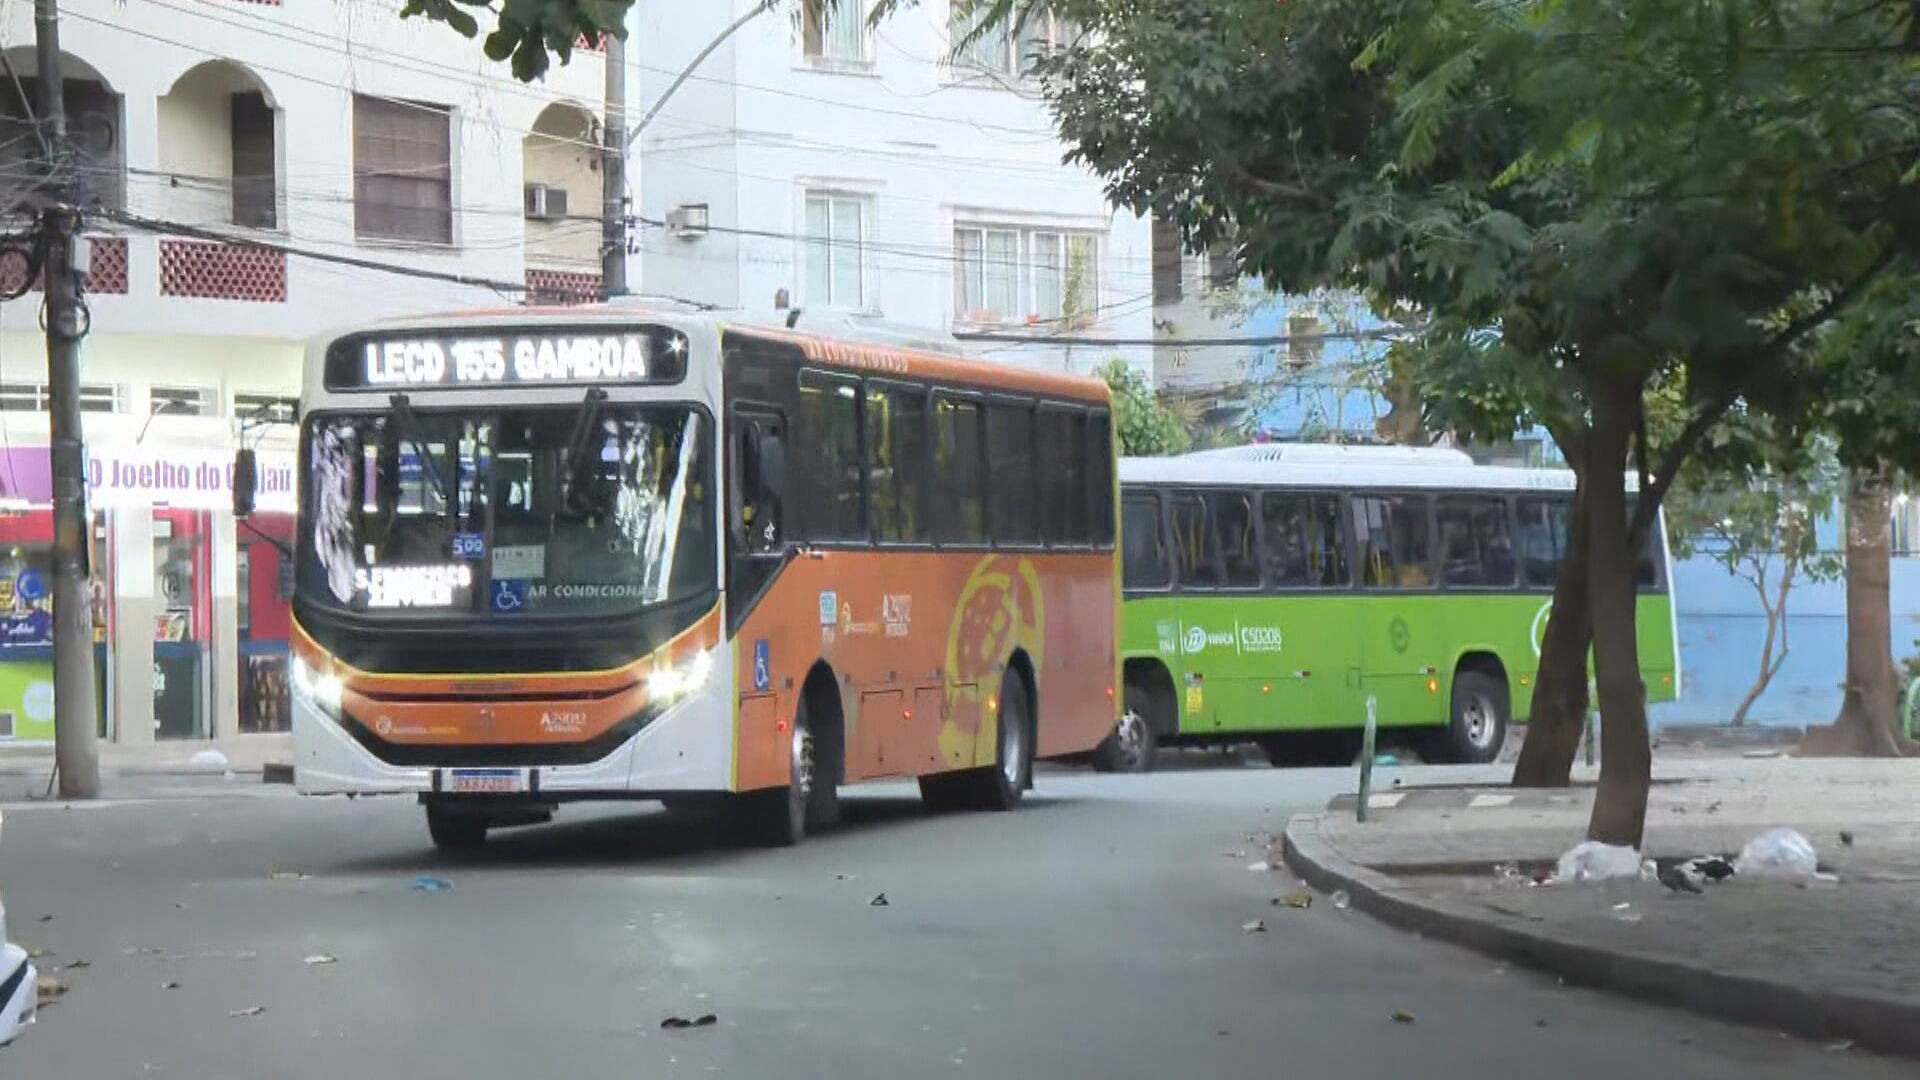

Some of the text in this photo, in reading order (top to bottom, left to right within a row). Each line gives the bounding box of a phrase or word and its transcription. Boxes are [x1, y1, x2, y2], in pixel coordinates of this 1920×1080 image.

[366, 337, 646, 383] LECD 155 GAMBOA
[110, 459, 190, 490] Joelho
[195, 461, 221, 491] do
[529, 585, 547, 597] AR
